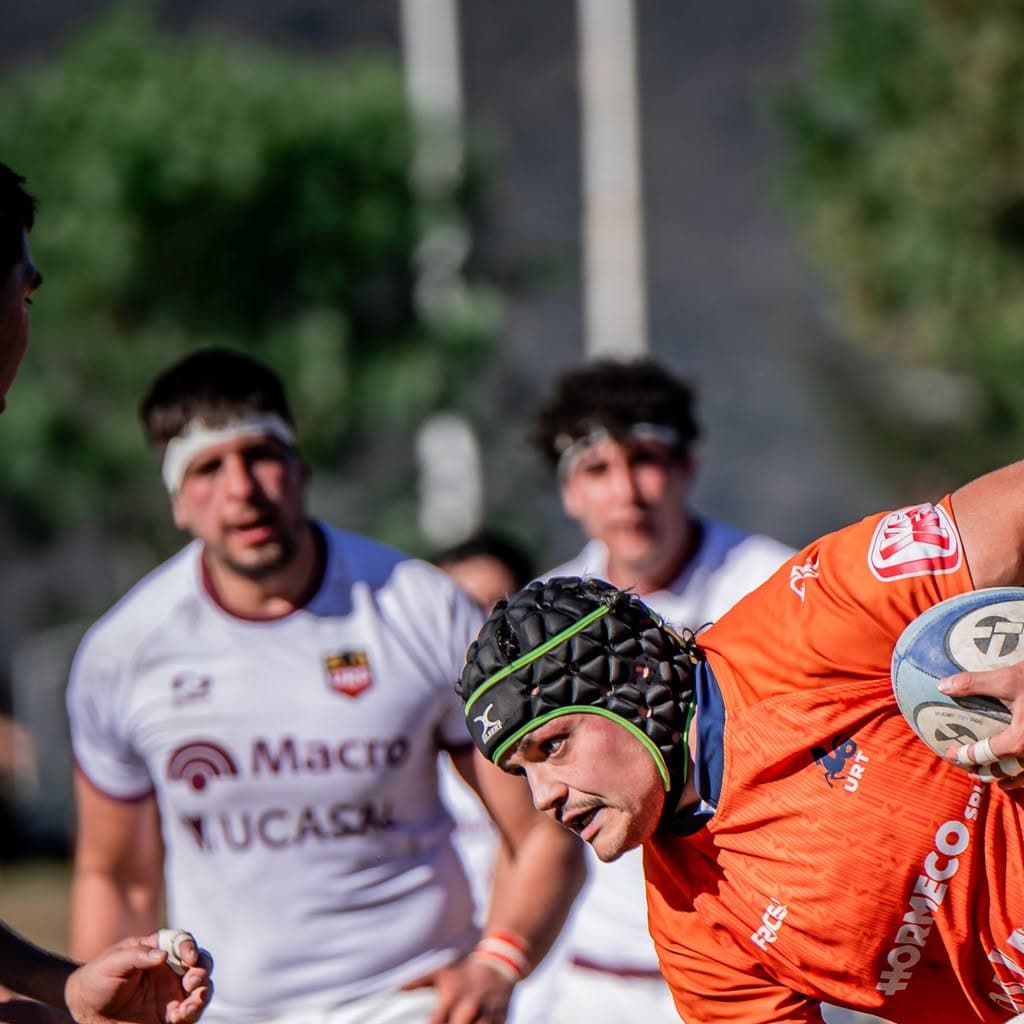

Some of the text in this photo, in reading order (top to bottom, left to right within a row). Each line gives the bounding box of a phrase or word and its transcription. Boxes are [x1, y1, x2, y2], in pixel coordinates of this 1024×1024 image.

[252, 734, 411, 777] Macro
[843, 750, 870, 793] URT
[876, 820, 971, 997] HORMECO
